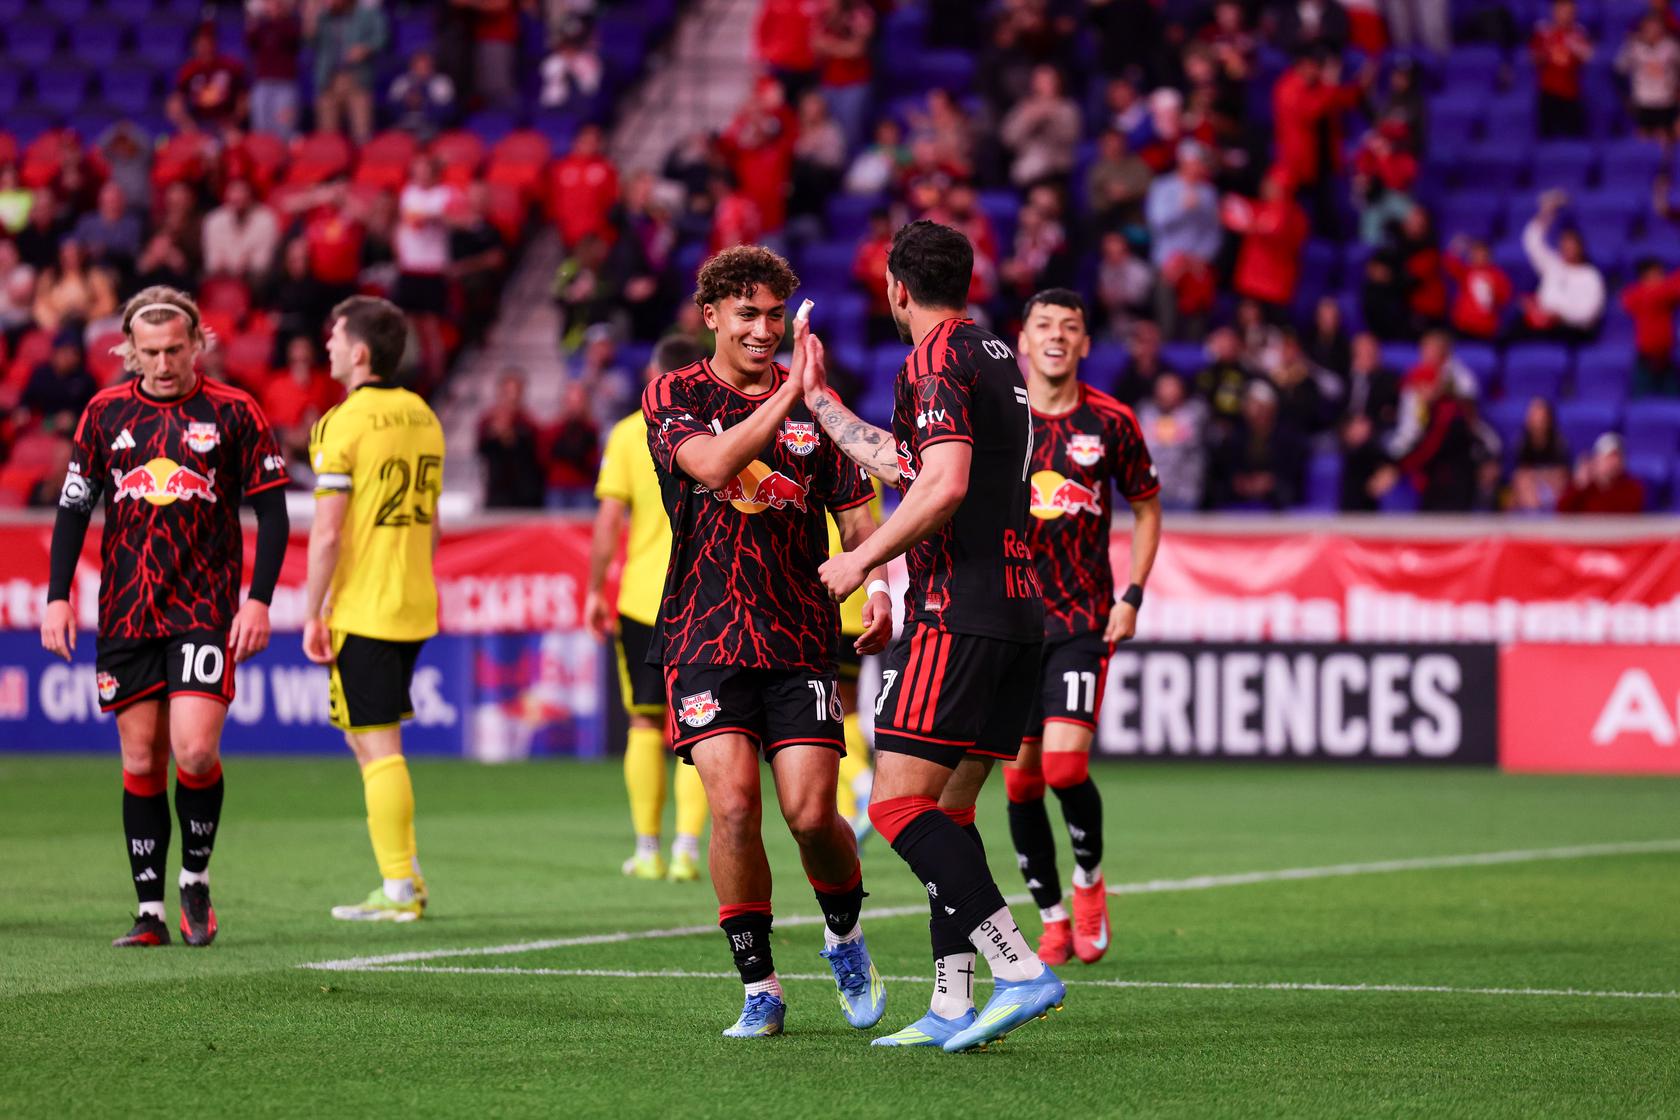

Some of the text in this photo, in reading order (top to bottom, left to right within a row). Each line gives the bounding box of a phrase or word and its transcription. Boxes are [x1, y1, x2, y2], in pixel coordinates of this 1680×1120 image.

[928, 409, 945, 423] tv
[374, 455, 442, 527] 25
[181, 643, 224, 684] 10
[807, 680, 844, 724] 16
[1063, 671, 1096, 713] 11
[1101, 651, 1462, 757] ERIENCES
[980, 920, 1019, 964] OTBALR
